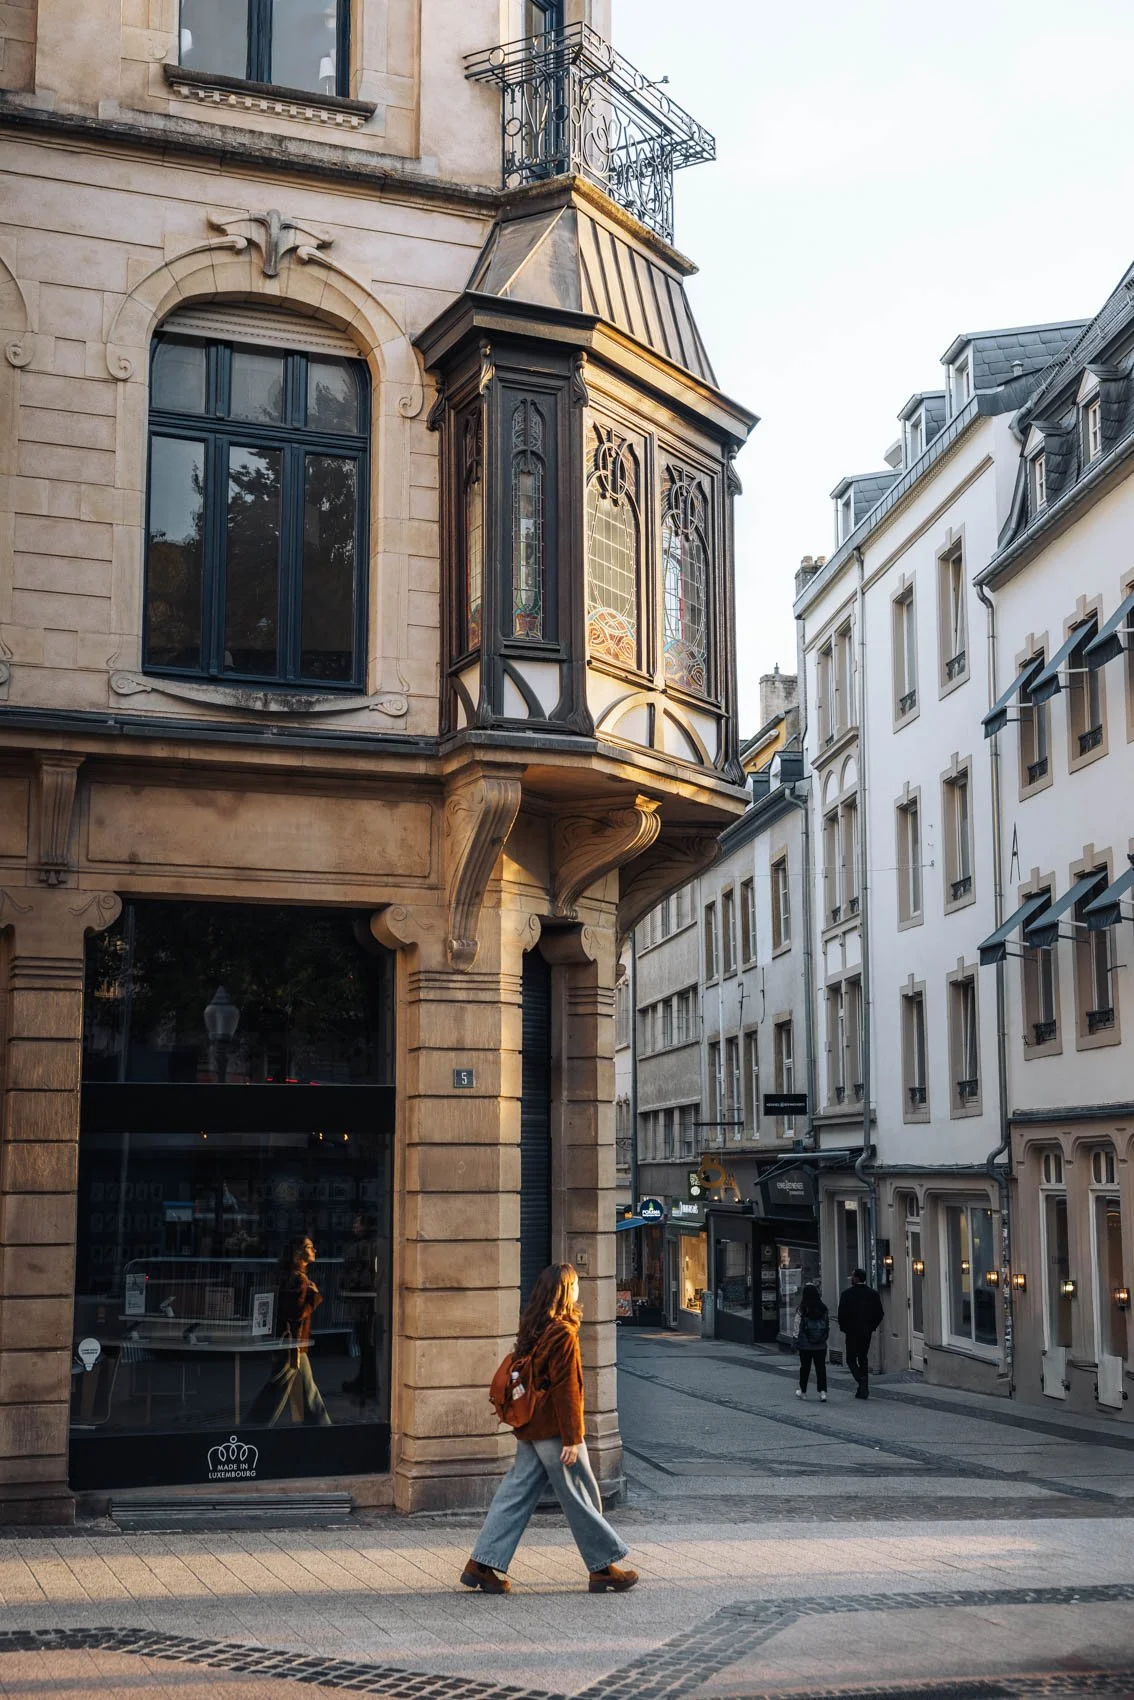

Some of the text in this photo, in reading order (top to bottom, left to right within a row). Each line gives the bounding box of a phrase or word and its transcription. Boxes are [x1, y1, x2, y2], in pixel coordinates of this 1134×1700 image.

[461, 1072, 468, 1084] 5
[217, 1463, 238, 1471] MADE
[208, 1470, 256, 1478] LUXEMBOURG
